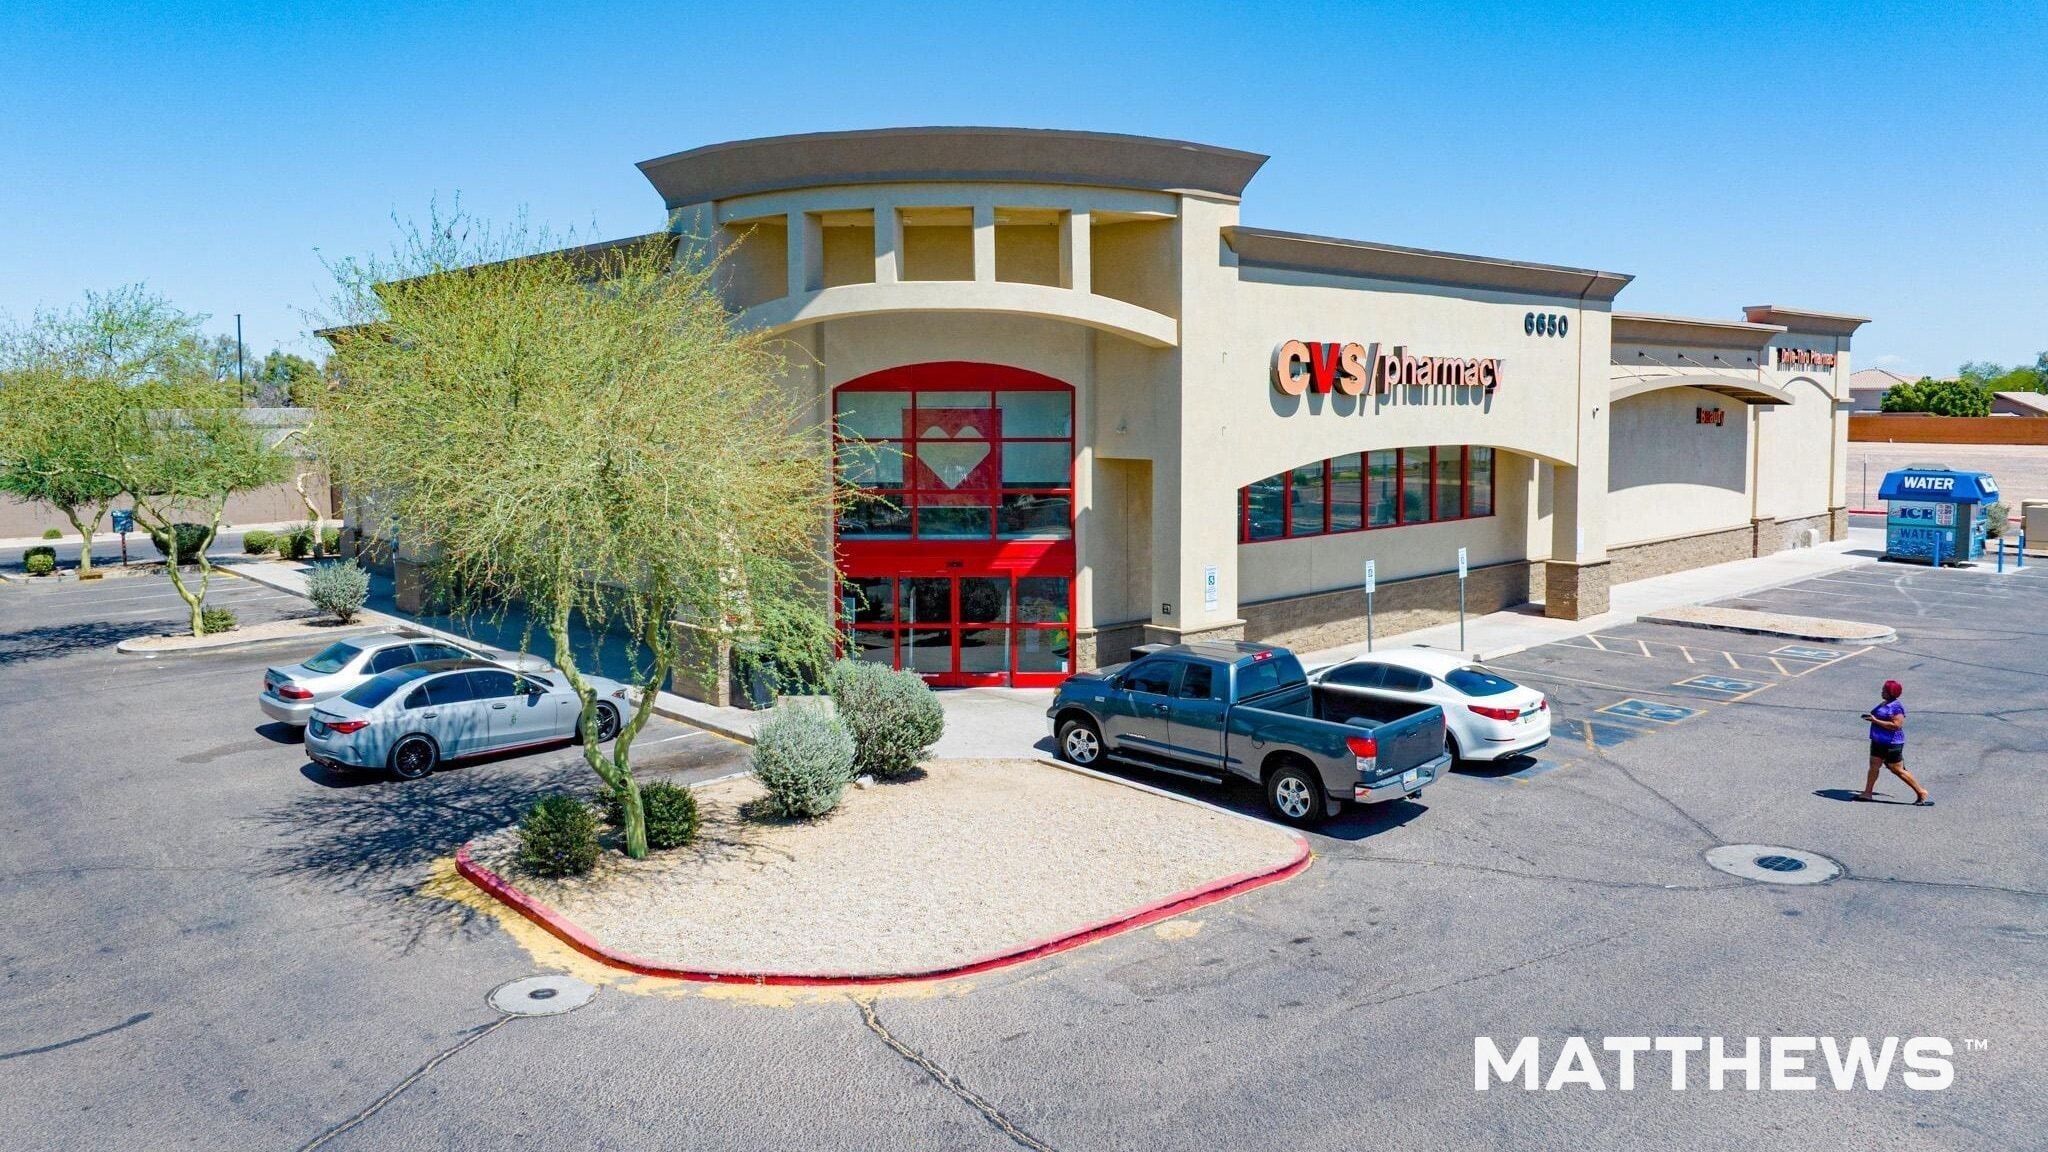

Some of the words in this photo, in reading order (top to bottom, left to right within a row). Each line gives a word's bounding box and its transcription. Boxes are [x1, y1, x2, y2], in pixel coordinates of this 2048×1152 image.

[1525, 312, 1568, 338] 6650
[1904, 476, 1954, 490] WATER
[1900, 507, 1933, 520] ICE
